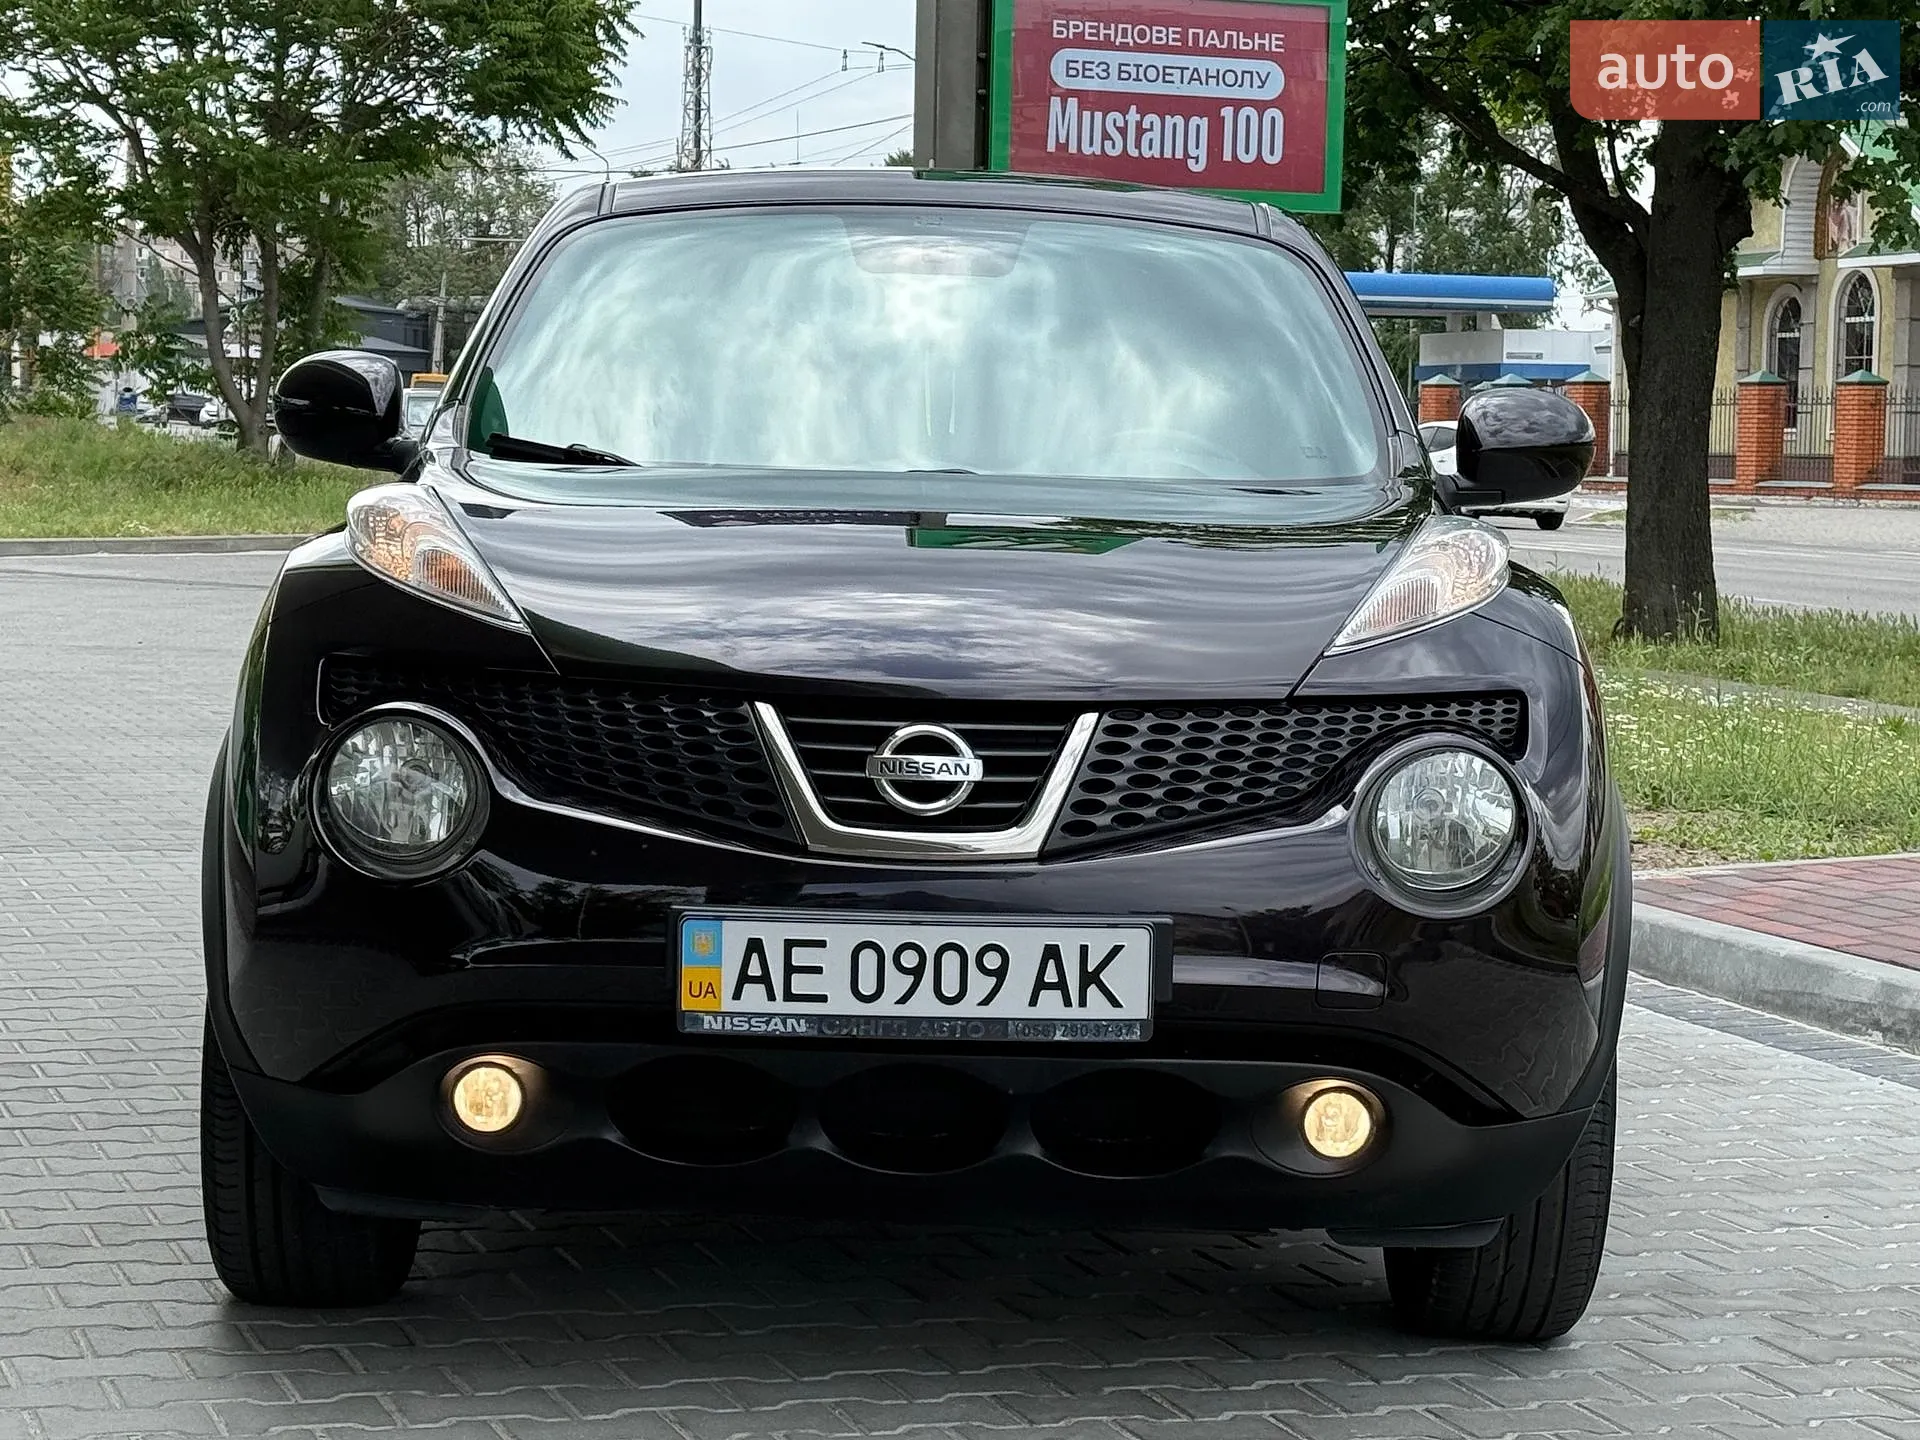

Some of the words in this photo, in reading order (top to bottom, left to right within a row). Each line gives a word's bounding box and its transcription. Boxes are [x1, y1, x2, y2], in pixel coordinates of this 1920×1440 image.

[1052, 19, 1182, 47] БРЕНДОВЕ
[1188, 28, 1285, 53] ПАЛЬНЕ
[1065, 59, 1111, 80] БЕЗ
[1117, 62, 1271, 90] БІОЕТАНОЛУ
[1047, 96, 1209, 173] Mustang
[1220, 106, 1285, 165] 100
[879, 760, 970, 777] NISSAN
[731, 937, 829, 1004] AE
[850, 940, 1011, 1007] 0909
[1028, 943, 1127, 1010] AK
[688, 981, 717, 1001] UA
[703, 1015, 807, 1035] NISSAN
